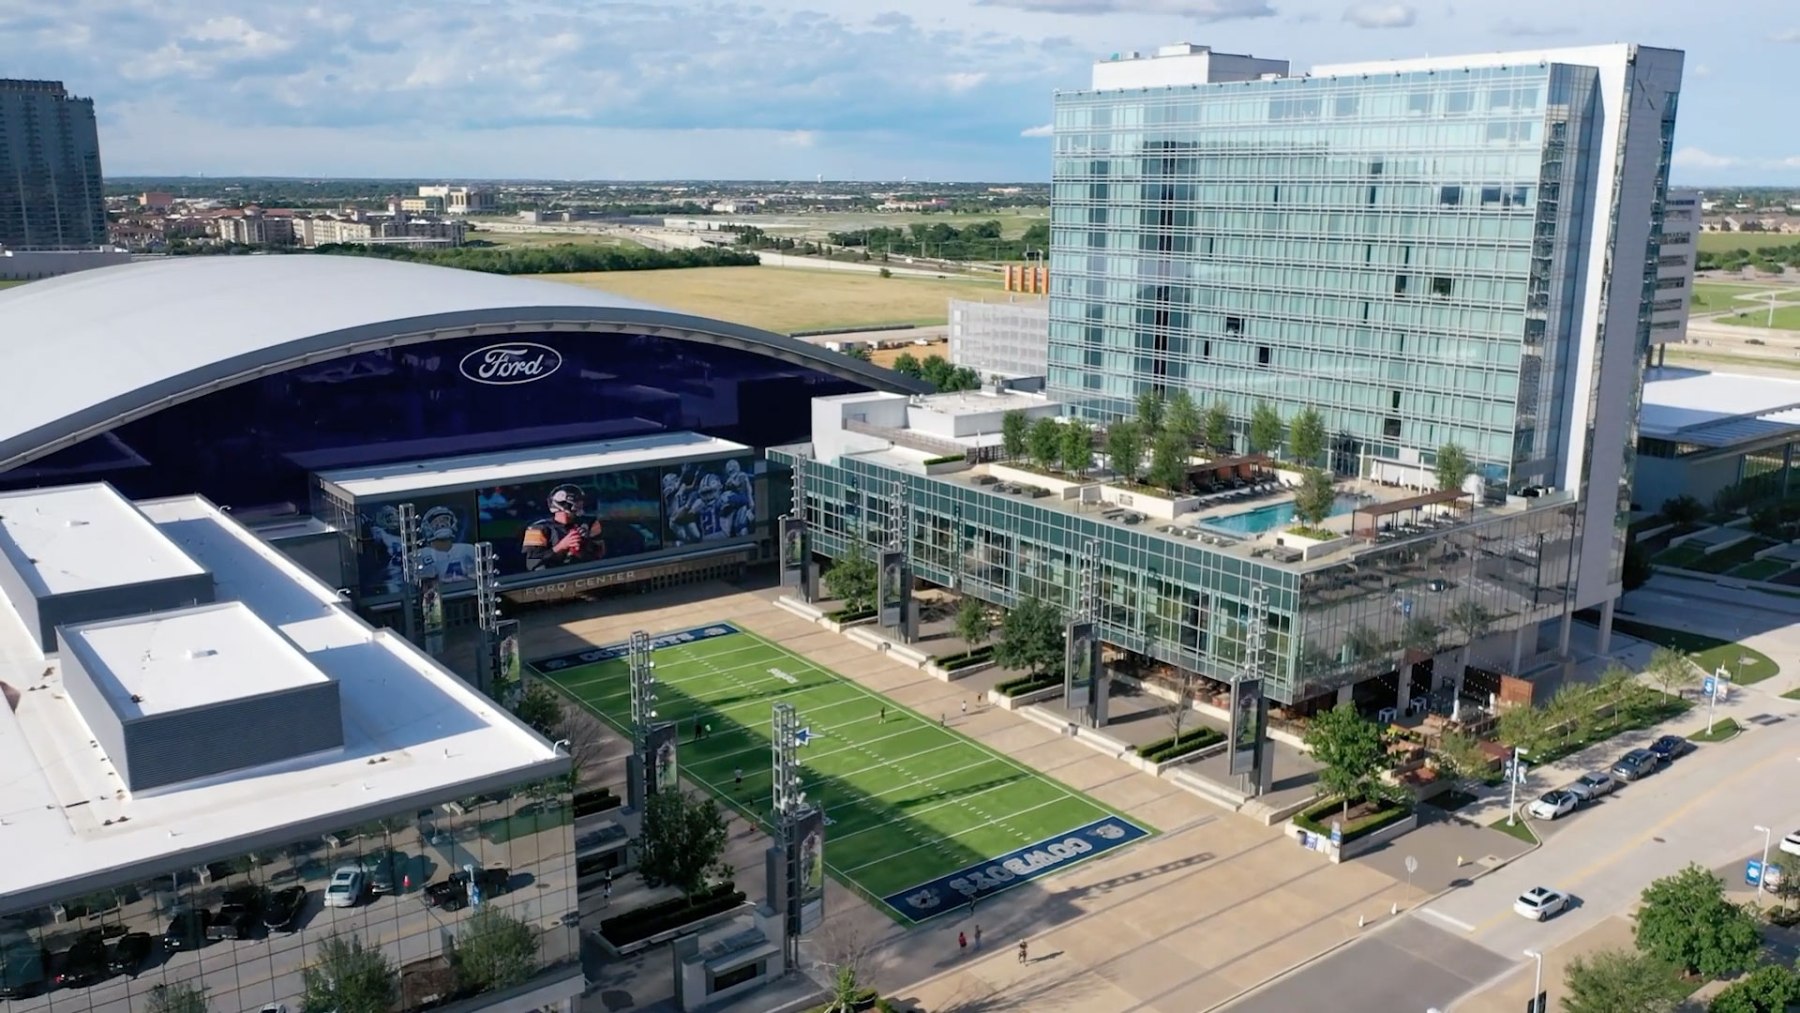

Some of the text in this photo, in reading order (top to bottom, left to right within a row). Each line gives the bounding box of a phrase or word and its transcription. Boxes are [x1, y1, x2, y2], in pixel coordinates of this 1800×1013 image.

[478, 349, 544, 378] Ford
[575, 570, 635, 588] CENTER
[949, 838, 1093, 896] COWBOYS
